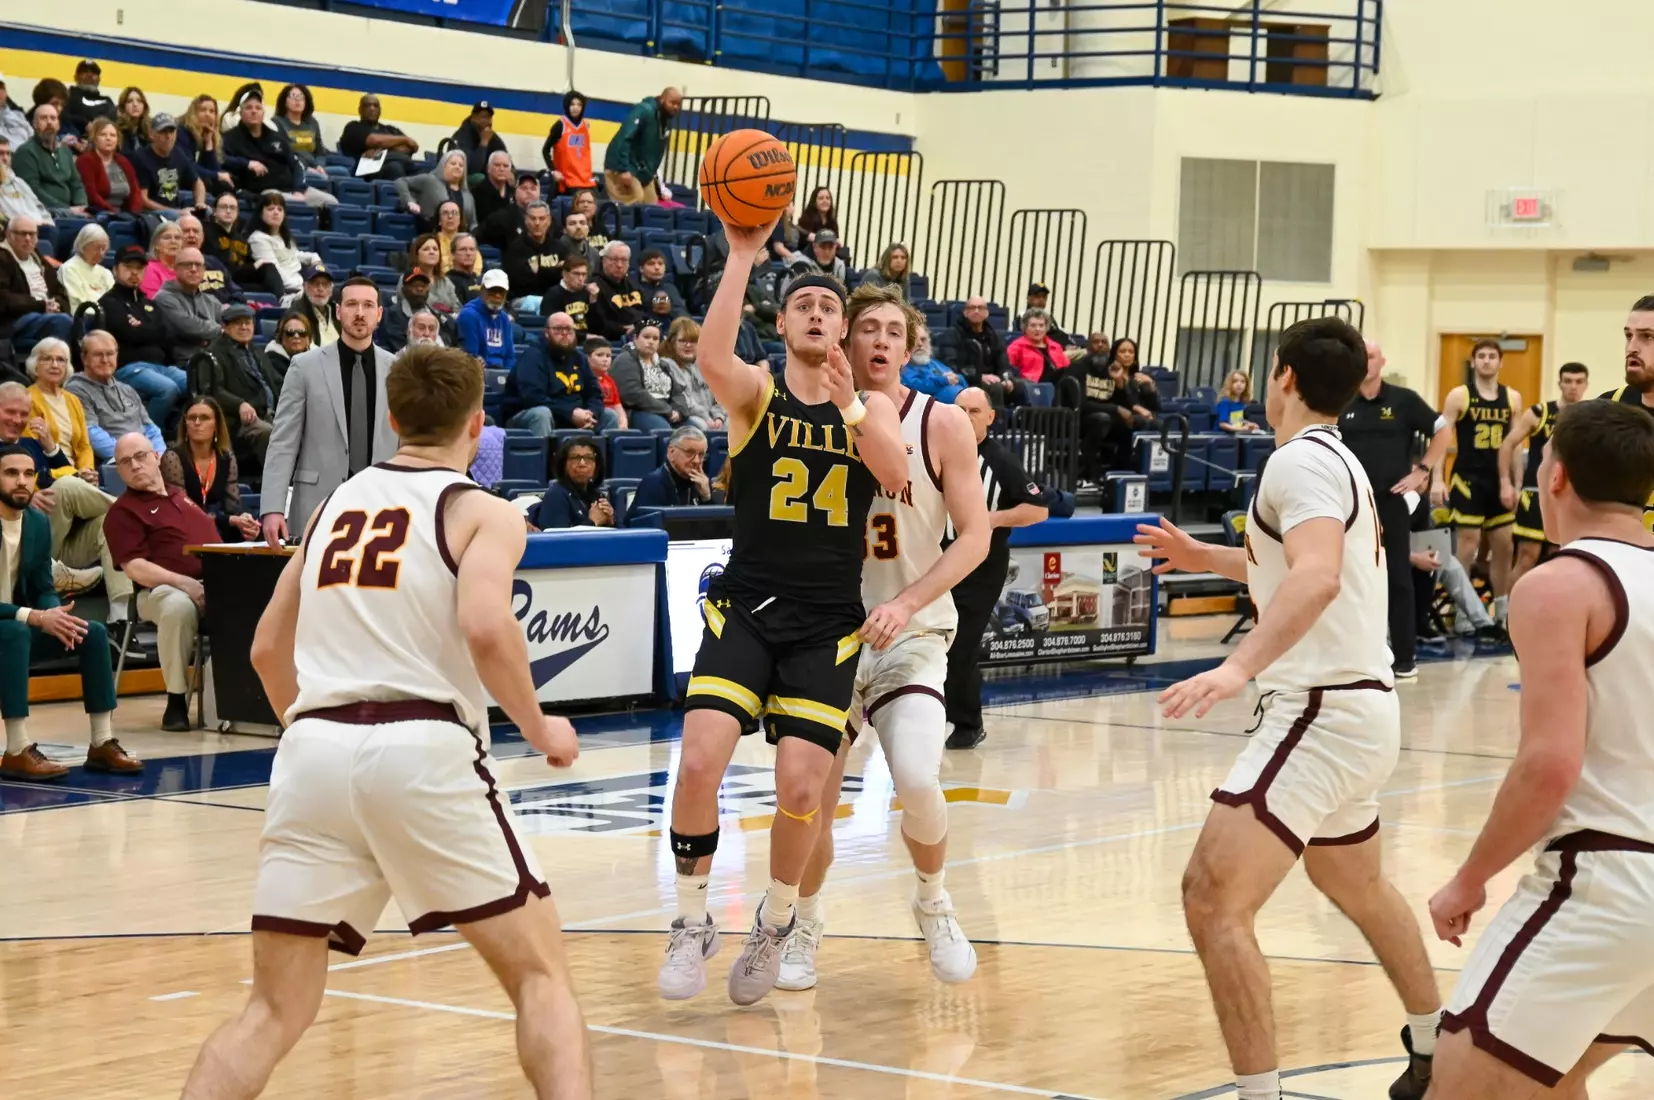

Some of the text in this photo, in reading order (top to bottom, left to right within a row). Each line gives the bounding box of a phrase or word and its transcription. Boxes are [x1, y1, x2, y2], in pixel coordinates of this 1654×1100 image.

[1469, 407, 1510, 424] VILLE
[768, 456, 850, 527] 24
[316, 504, 412, 591] 22
[990, 638, 1035, 651] 304.876.2500
[1043, 635, 1086, 648] 304.876.7000
[1100, 631, 1142, 643] 304.876.3160
